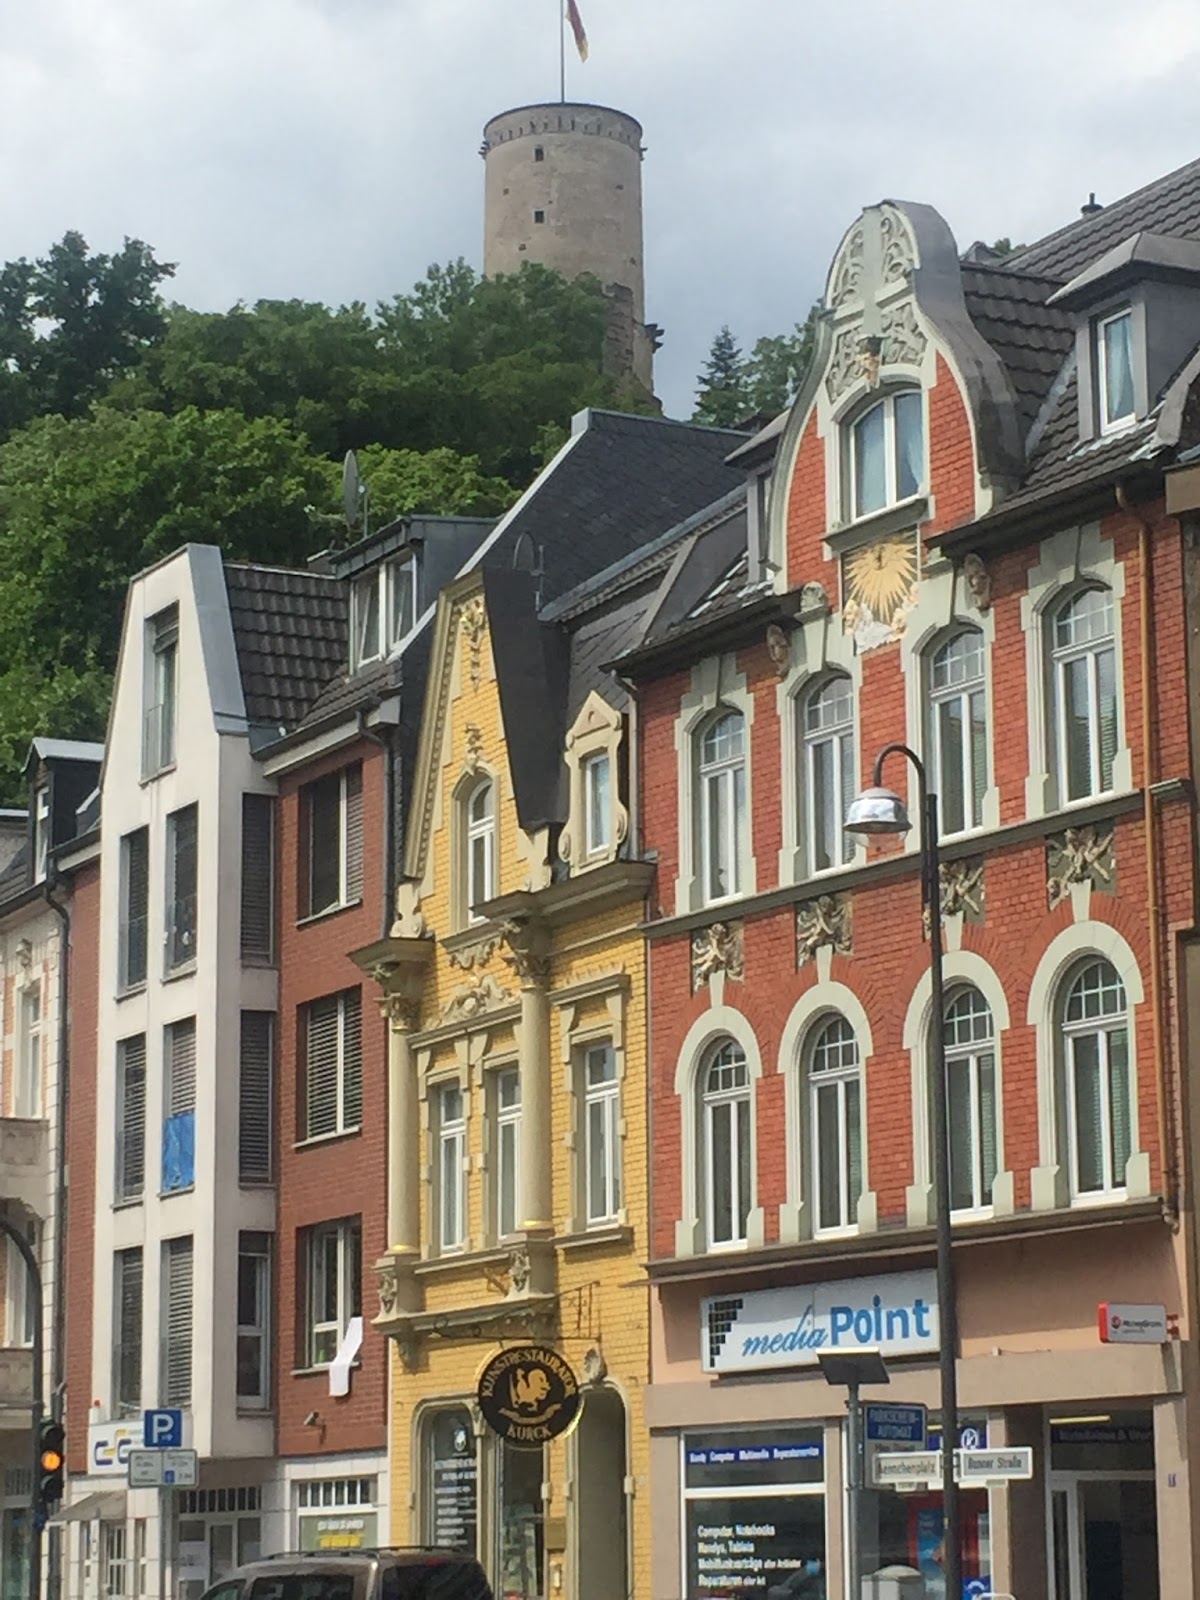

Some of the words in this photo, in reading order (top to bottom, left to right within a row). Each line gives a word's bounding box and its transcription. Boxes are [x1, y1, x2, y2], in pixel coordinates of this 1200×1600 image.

[742, 1303, 828, 1357] media
[830, 1294, 931, 1346] Point
[152, 1413, 174, 1444] P
